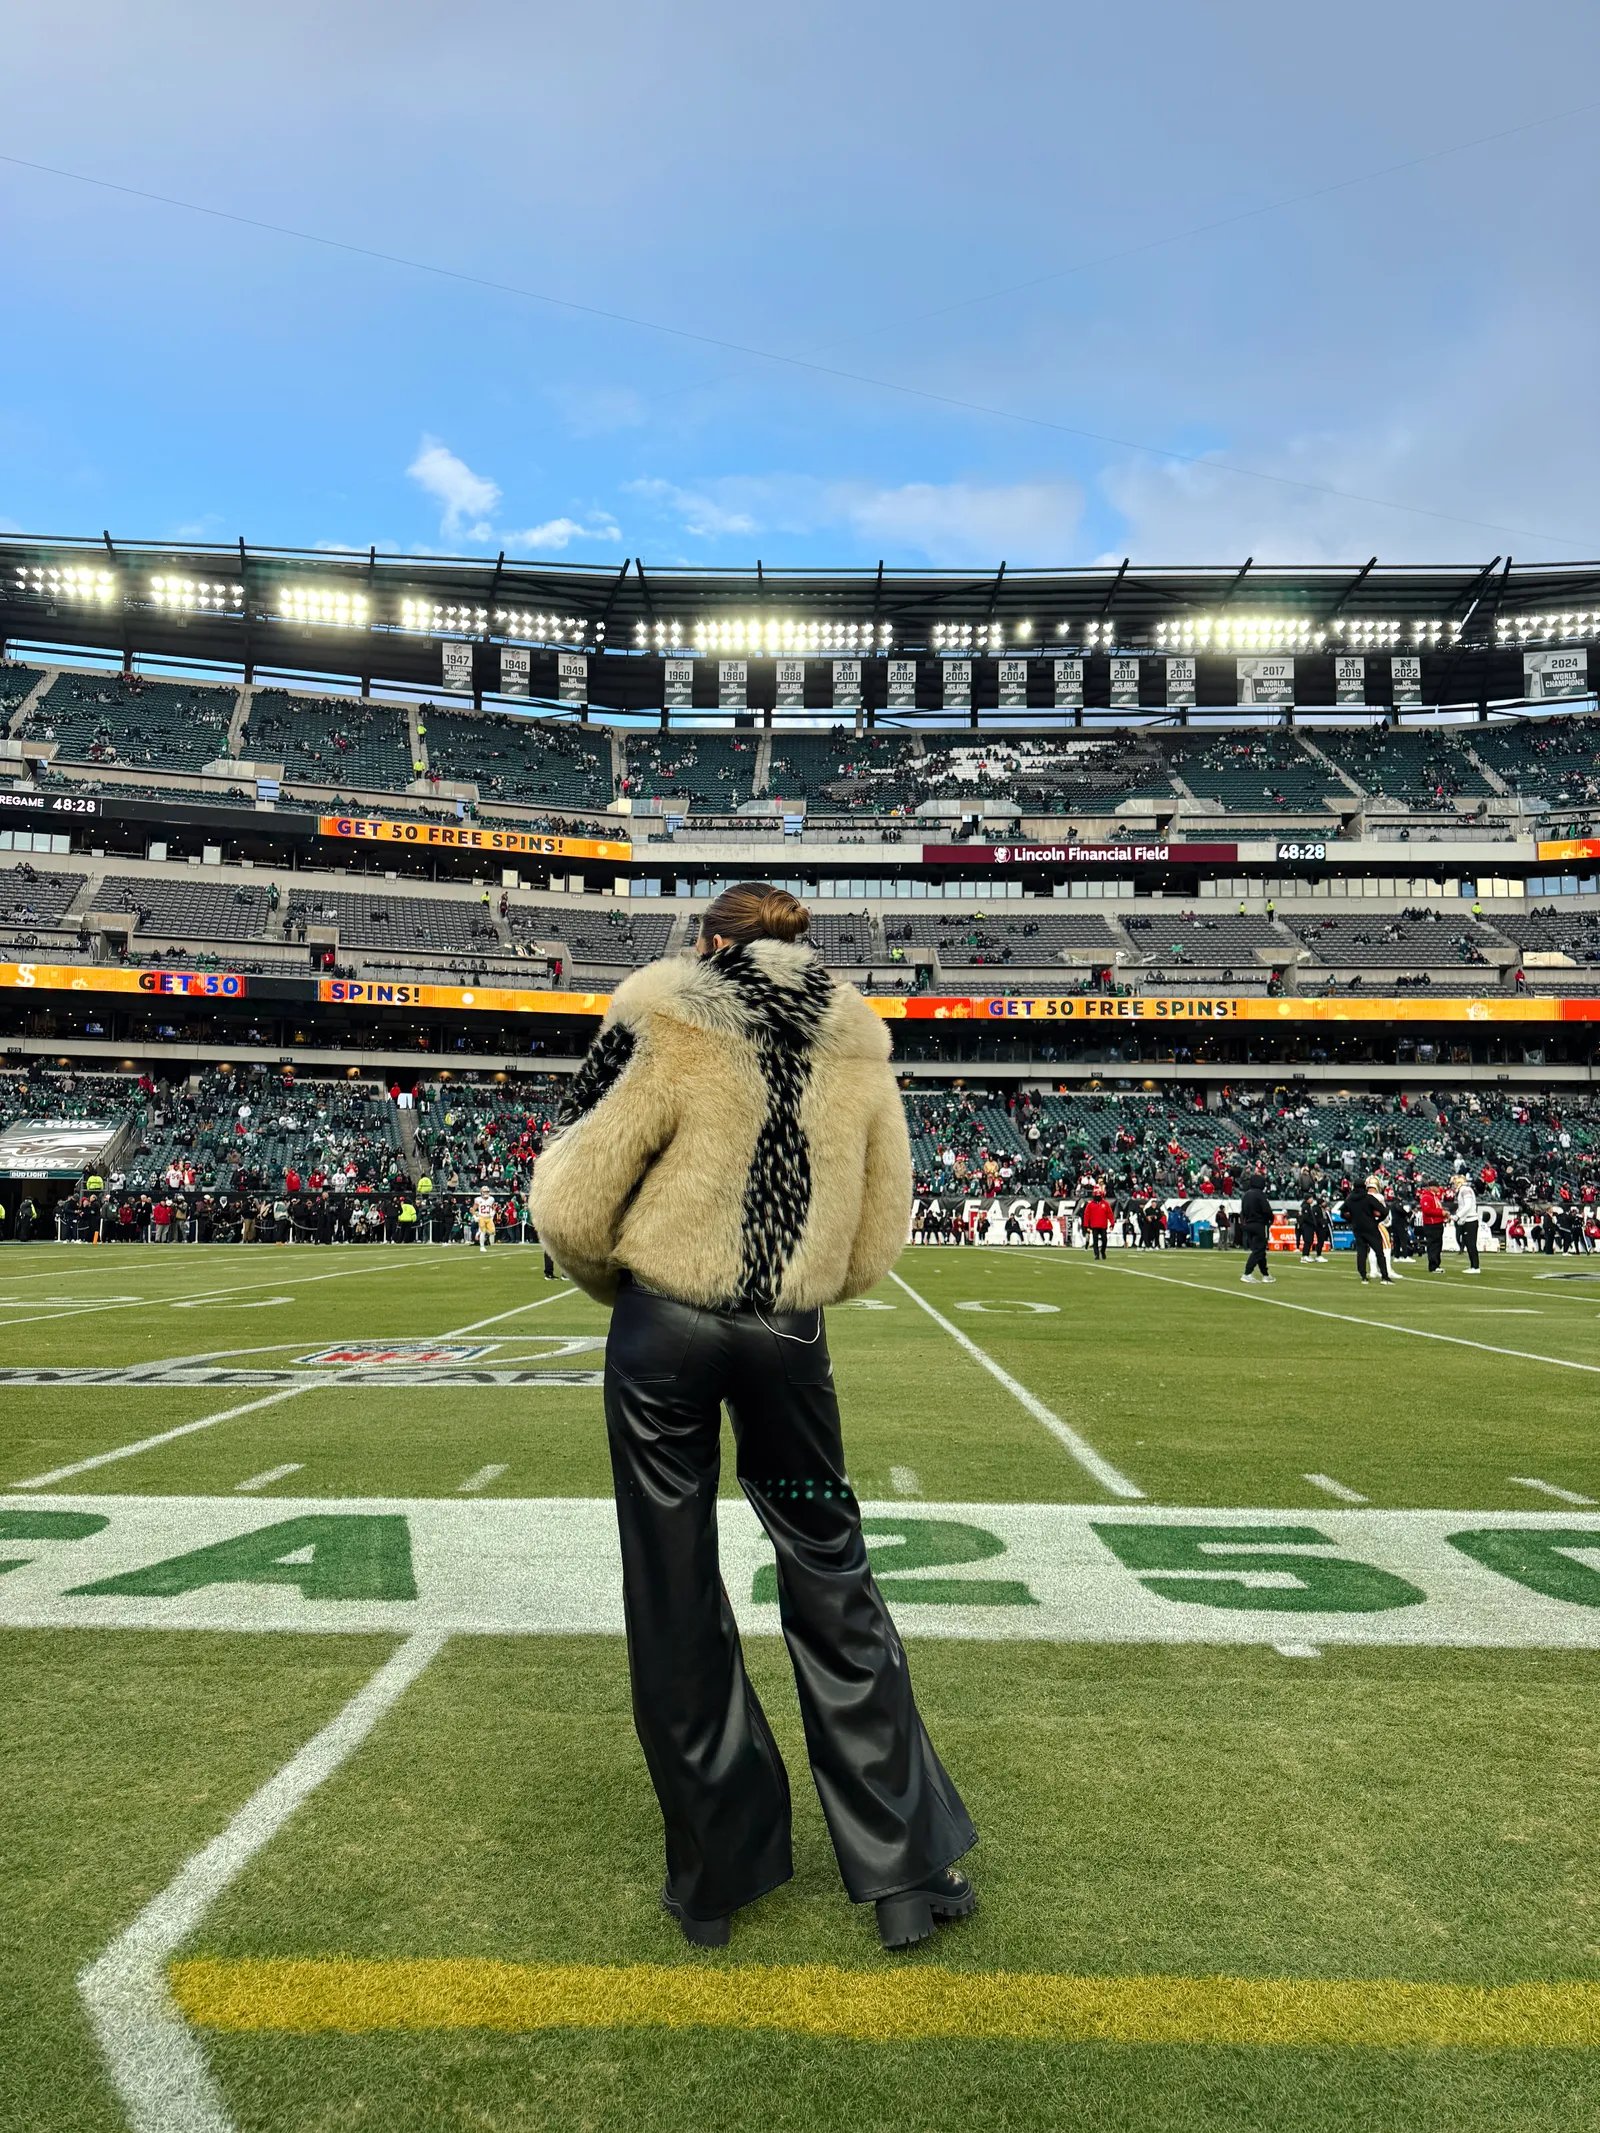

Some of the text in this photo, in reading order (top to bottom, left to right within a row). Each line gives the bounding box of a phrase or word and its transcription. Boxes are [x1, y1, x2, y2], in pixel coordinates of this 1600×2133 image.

[446, 655, 469, 665] 1947
[1552, 658, 1578, 669] 2024
[505, 660, 527, 671] 1948
[563, 665, 584, 676] 1949
[669, 671, 690, 680] 1960
[723, 671, 744, 681] 1980
[780, 671, 801, 681] 1988
[1001, 671, 1025, 681] 2004
[1057, 670, 1081, 680] 2006
[1114, 670, 1135, 679] 2010
[1170, 669, 1192, 679] 2013
[1263, 666, 1285, 676] 2017
[1340, 668, 1361, 678] 2019
[1394, 668, 1418, 678] 2022
[1552, 672, 1577, 680] WORLD
[836, 672, 858, 681] 2001
[890, 672, 913, 681] 2002
[946, 672, 969, 681] 2003
[1545, 679, 1585, 688] CHAMPIONS
[53, 798, 96, 812] 48:28
[337, 820, 564, 853] GET 50 FREE SPINS!
[1014, 847, 1168, 861] Lincoln Financial Field
[1278, 844, 1325, 860] 48:28
[139, 973, 239, 995] GET 50
[331, 983, 421, 1003] SPINS!
[989, 1000, 1239, 1017] GET 50 FREE SPINS!
[963, 1199, 1086, 1222] EAGLE
